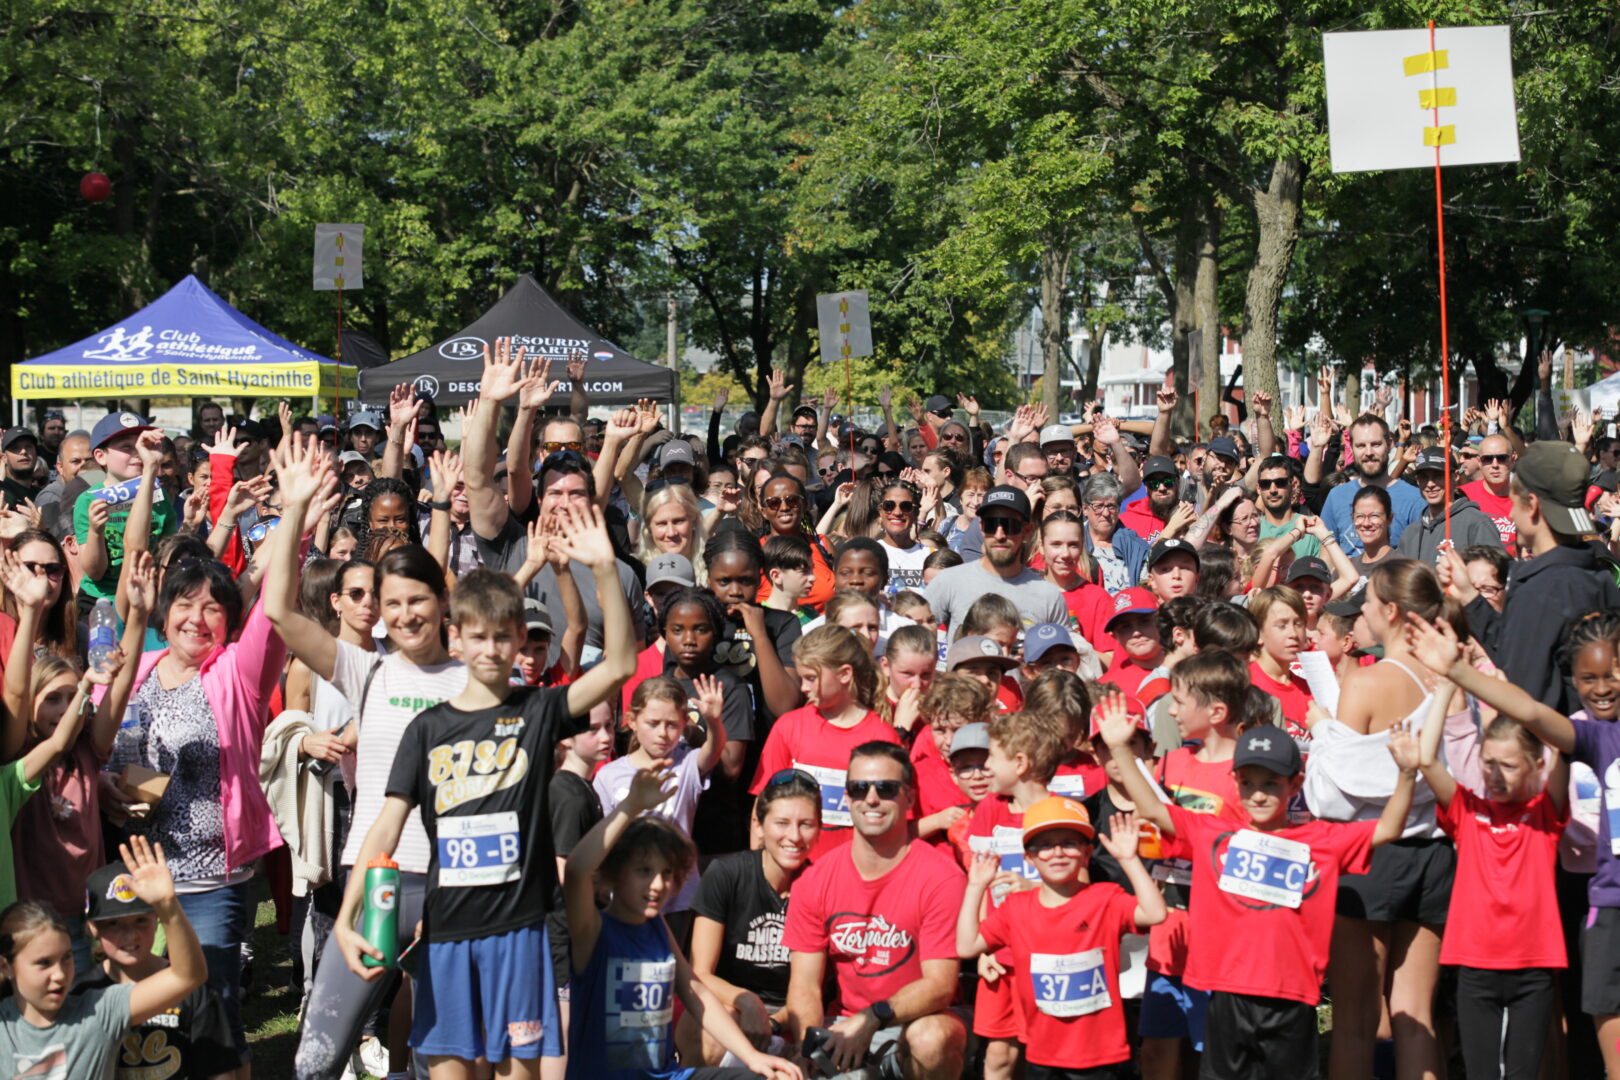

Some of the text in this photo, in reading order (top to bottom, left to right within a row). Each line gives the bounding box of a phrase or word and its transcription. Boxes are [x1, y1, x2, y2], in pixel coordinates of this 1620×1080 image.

[156, 341, 256, 356] athlétique
[160, 329, 200, 343] Club
[20, 368, 312, 390] Club athlétique de Saint-Hyacinthe
[102, 485, 130, 504] 35
[446, 833, 520, 868] 98 -B
[1232, 850, 1305, 891] 35 -C
[830, 921, 912, 954] Tornades
[632, 983, 663, 1010] 30
[1040, 974, 1070, 1001] 37
[1079, 967, 1107, 996] -A
